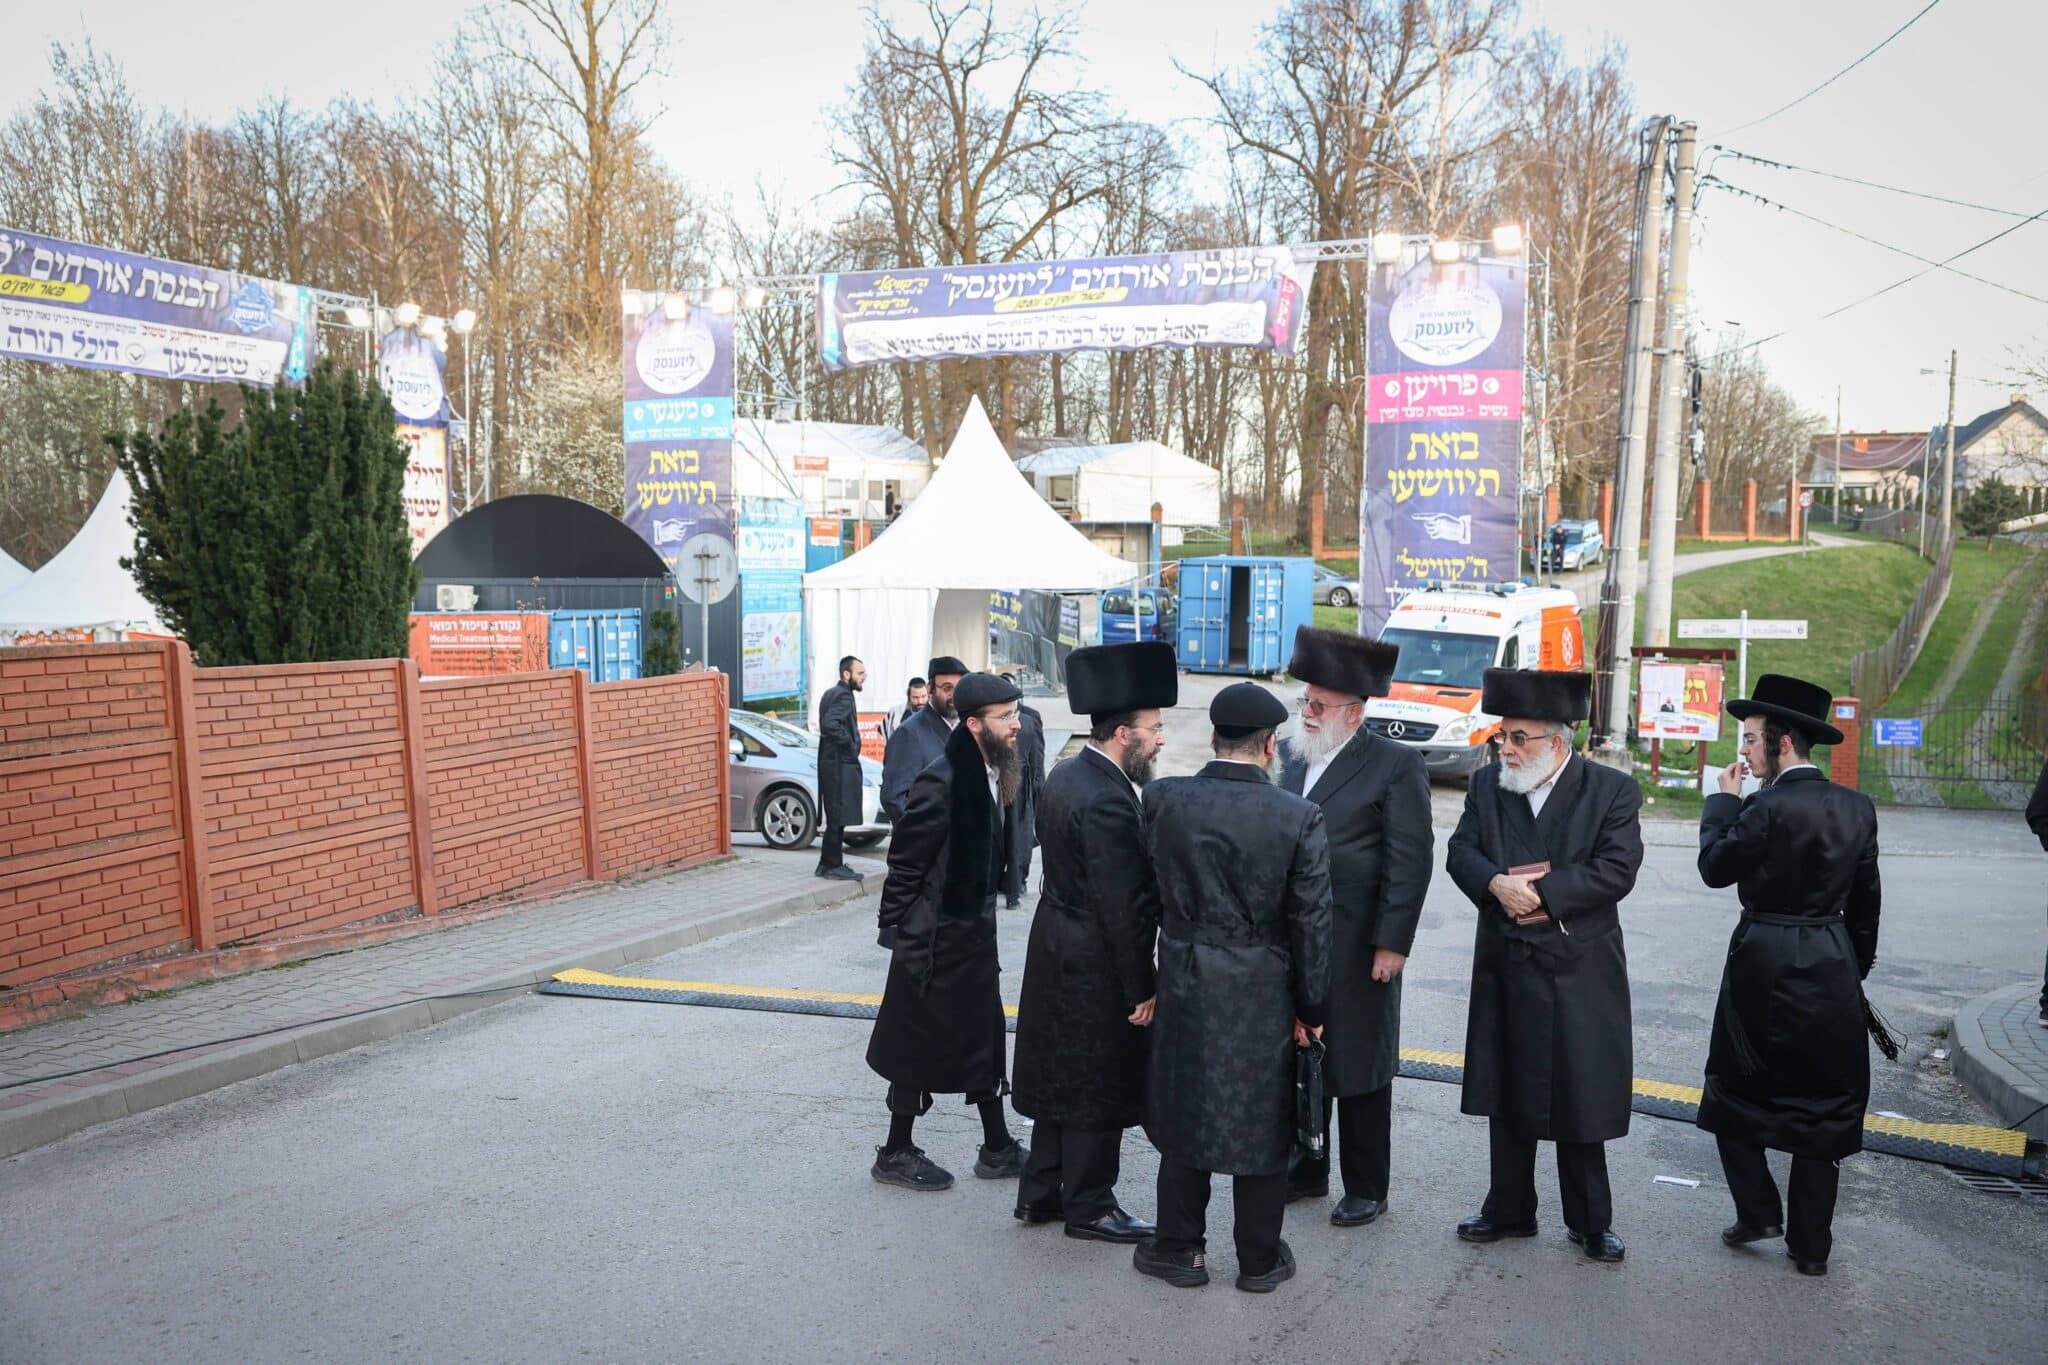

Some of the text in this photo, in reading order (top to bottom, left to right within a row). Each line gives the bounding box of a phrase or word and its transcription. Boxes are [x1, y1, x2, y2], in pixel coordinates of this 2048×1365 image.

[30, 247, 134, 294] אורחים
[1070, 263, 1172, 292] אורחים
[1177, 256, 1275, 288] הכנסת
[135, 267, 220, 310] הכנסת
[1099, 323, 1125, 342] של
[1414, 317, 1475, 340] ליזענסק
[7, 325, 119, 361] היכל תורה
[1404, 374, 1479, 407] פרויען
[646, 400, 699, 424] מענער
[1479, 405, 1508, 417] נשים
[1407, 432, 1480, 461] בזאת
[648, 449, 699, 475] בזאת
[636, 480, 717, 511] תיוושעו
[1387, 468, 1501, 504] תיוושעו
[429, 620, 458, 632] רפואי
[429, 633, 522, 644] Medical Treatment Station
[459, 618, 489, 632] טיפול
[1376, 702, 1433, 713] AMBULANCE
